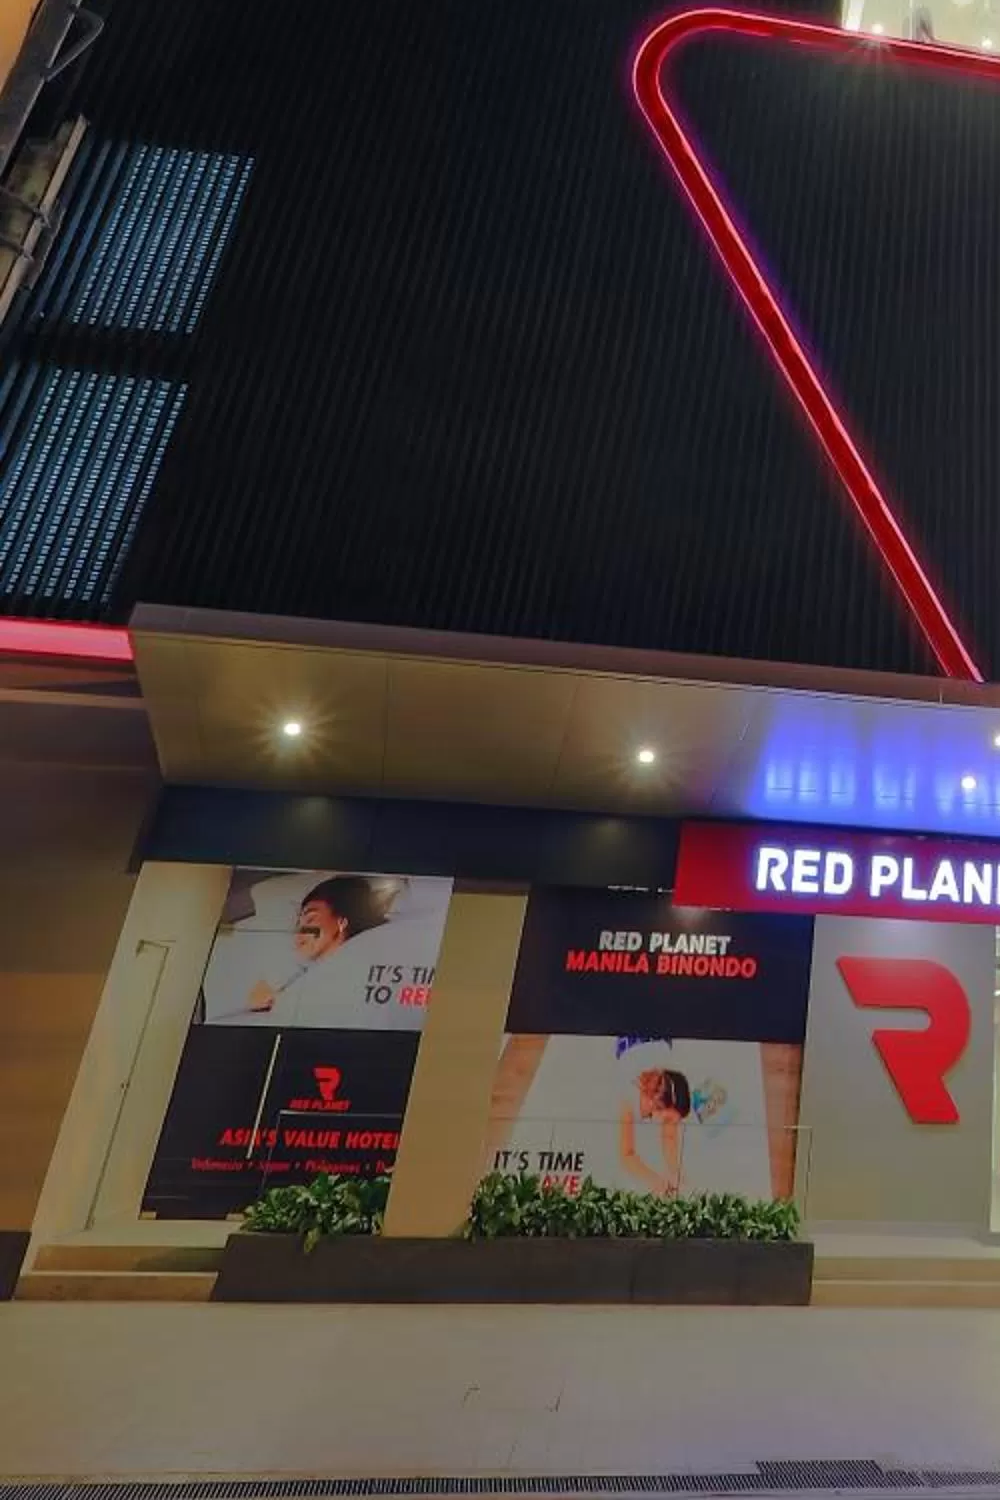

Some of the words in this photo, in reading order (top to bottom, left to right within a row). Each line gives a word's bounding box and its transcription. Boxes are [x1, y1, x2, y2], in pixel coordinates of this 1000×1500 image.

[756, 846, 853, 894] RED
[599, 930, 643, 951] RED
[649, 931, 731, 955] PLANET
[367, 965, 404, 983] IT'S
[565, 950, 649, 973] MANILA
[656, 955, 757, 978] BINONDO
[364, 985, 392, 1005] TO
[283, 1130, 341, 1149] VALUE
[494, 1150, 529, 1171] IT'S
[538, 1151, 585, 1172] TIME
